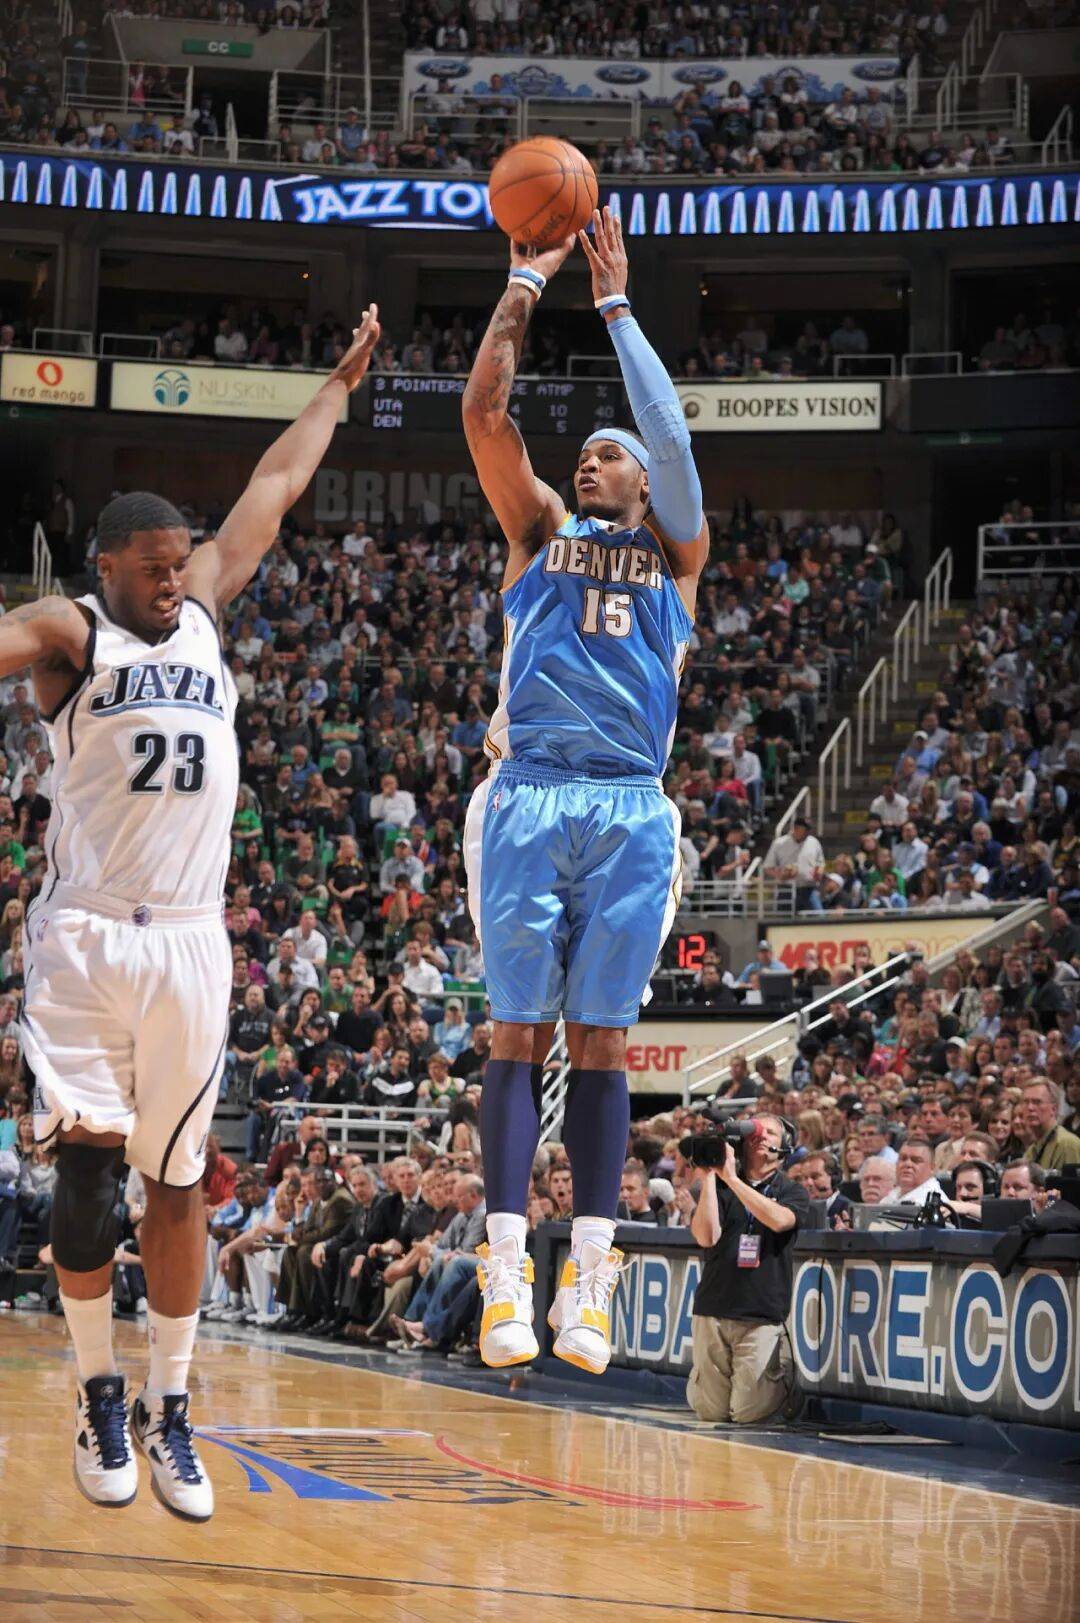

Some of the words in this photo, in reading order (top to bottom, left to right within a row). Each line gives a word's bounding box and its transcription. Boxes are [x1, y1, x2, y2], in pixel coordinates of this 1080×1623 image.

[294, 180, 409, 223] JAZZ
[12, 386, 35, 398] red
[39, 389, 86, 403] mango
[373, 398, 403, 411] UTA
[549, 404, 568, 417] 10
[717, 399, 799, 417] HOOPES
[806, 397, 877, 416] VISION
[314, 468, 481, 524] BRING
[544, 535, 662, 592] DENVER
[581, 586, 632, 637] 15
[128, 730, 206, 795] 23
[678, 934, 706, 970] 12
[626, 1044, 688, 1072] ERIT
